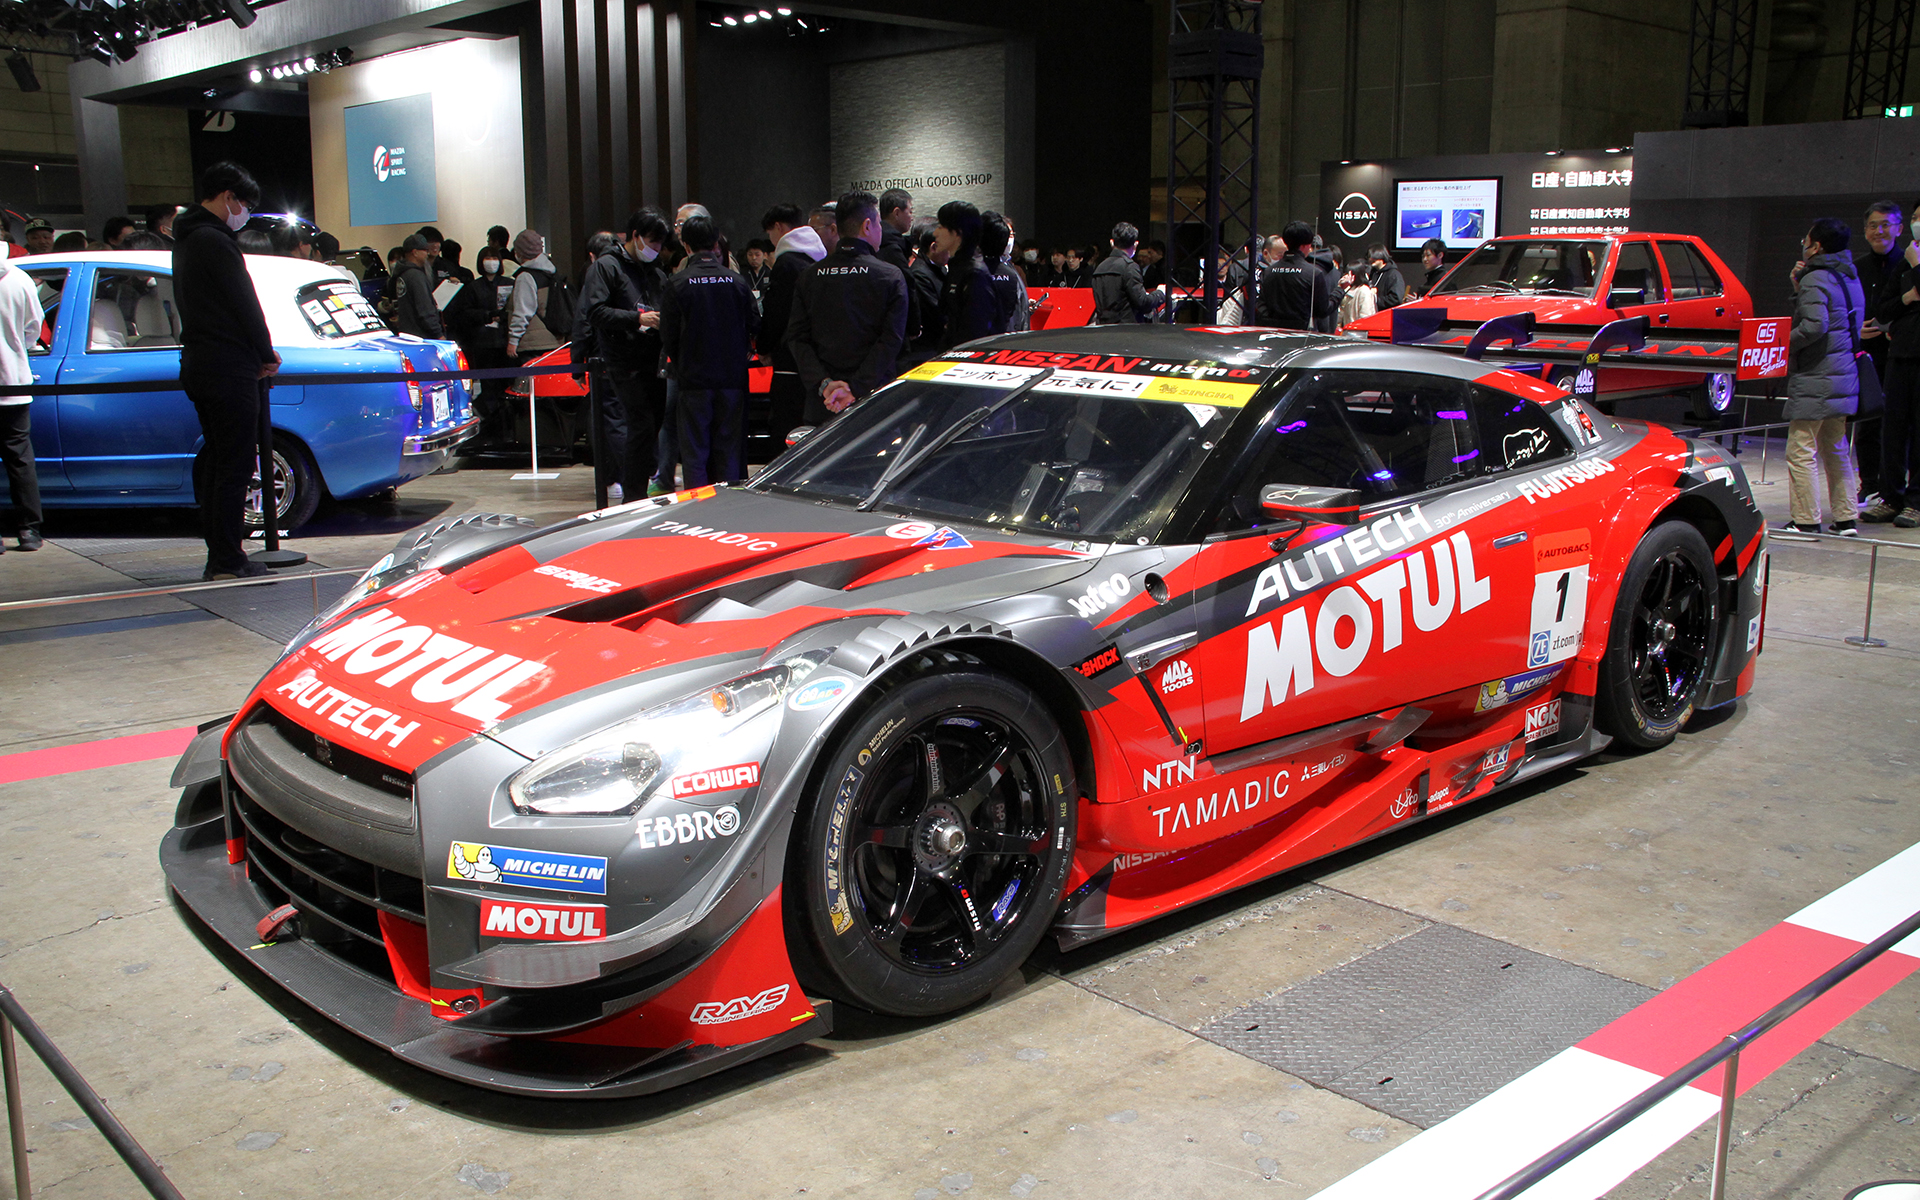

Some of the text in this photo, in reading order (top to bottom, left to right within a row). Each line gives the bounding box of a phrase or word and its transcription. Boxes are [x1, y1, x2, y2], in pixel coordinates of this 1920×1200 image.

[851, 173, 992, 191] MAZDA OFFICIAL GOODS SHOP
[1334, 211, 1377, 220] NISSAN
[688, 276, 734, 285] NISSAN
[817, 266, 869, 276] NISSAN
[983, 349, 1143, 373] NISSAN
[1149, 362, 1251, 379] nismo
[1741, 347, 1786, 367] CRAFT
[1758, 359, 1786, 375] Sports
[1575, 368, 1594, 387] MAC
[1575, 386, 1594, 394] TOOLS
[1178, 388, 1235, 400] SINGHA
[1515, 457, 1616, 504] FUJITSUBO
[249, 529, 290, 538] WRK
[651, 520, 778, 552] TAMADIC
[1245, 490, 1512, 617] AUTECH 30th Anniversary
[1544, 543, 1590, 558] AUTOBACS
[1555, 571, 1571, 624] 1
[1240, 530, 1490, 723] MOTUL
[1533, 638, 1549, 659] ZF
[309, 608, 547, 722] MOTUL
[1161, 660, 1193, 687] MAC
[1162, 676, 1194, 694] TOOLS
[1511, 669, 1563, 693] MICHELIN
[276, 675, 421, 748] AUTECH
[1527, 701, 1560, 733] NGK
[868, 718, 894, 748] MICHELIN
[1542, 724, 1558, 737] PLUGS
[1143, 755, 1195, 792] NTN
[1153, 770, 1290, 837] TAMADIC
[635, 805, 740, 849] EBBRO
[503, 858, 605, 881] MICHELIN
[486, 905, 601, 937] MOTUL
[960, 889, 982, 931] nismo
[692, 986, 788, 1019] RAYS
[700, 1004, 776, 1023] ENGINEERING
